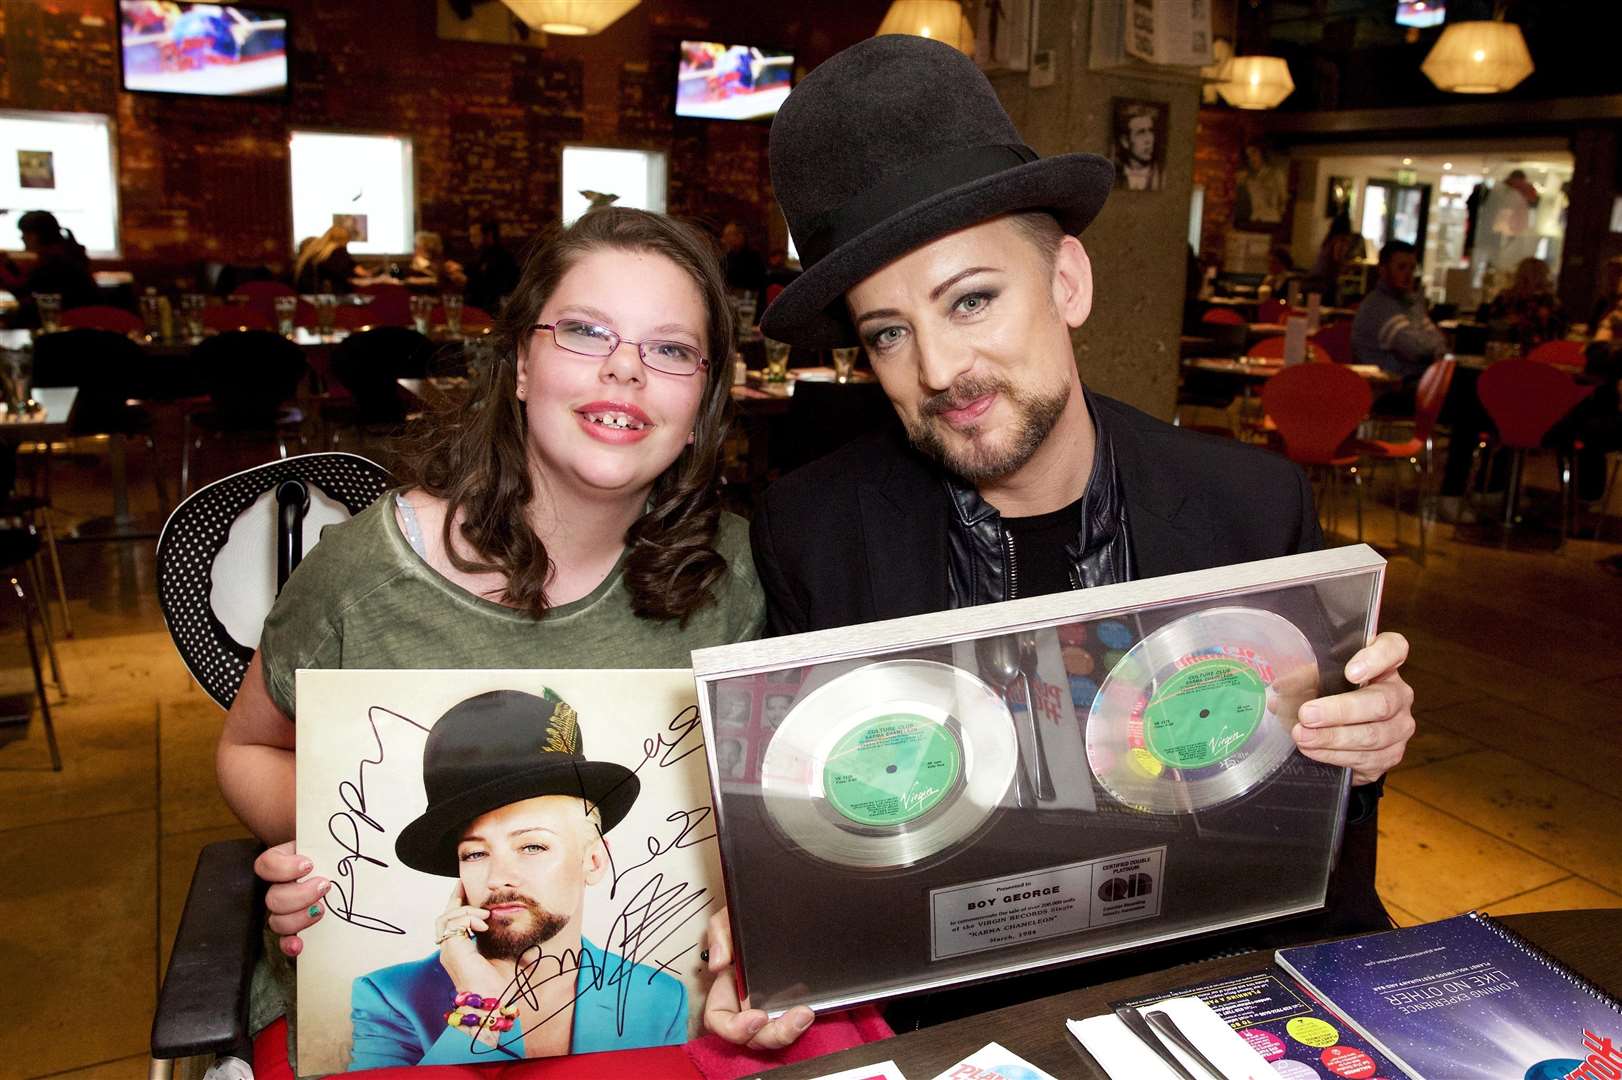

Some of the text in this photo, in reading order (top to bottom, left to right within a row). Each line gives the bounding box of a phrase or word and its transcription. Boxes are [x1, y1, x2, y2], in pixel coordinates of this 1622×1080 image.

[1208, 725, 1245, 756] Virgin
[901, 782, 939, 812] Virgin
[996, 882, 1024, 892] Presented
[967, 885, 1061, 911] BOY GEORGE
[978, 916, 1007, 928] VIRGIN
[1009, 909, 1049, 921] RECORDS
[990, 934, 1015, 943] March,
[1435, 966, 1469, 978] HOLLYWOOD
[1470, 962, 1491, 970] PLANET
[1398, 973, 1436, 986] RESTAURANT
[1226, 990, 1260, 1001] PLANNING
[1383, 970, 1510, 1006] LIKE NO OTHER
[1398, 980, 1520, 1015] A DINING EXPERIENCE
